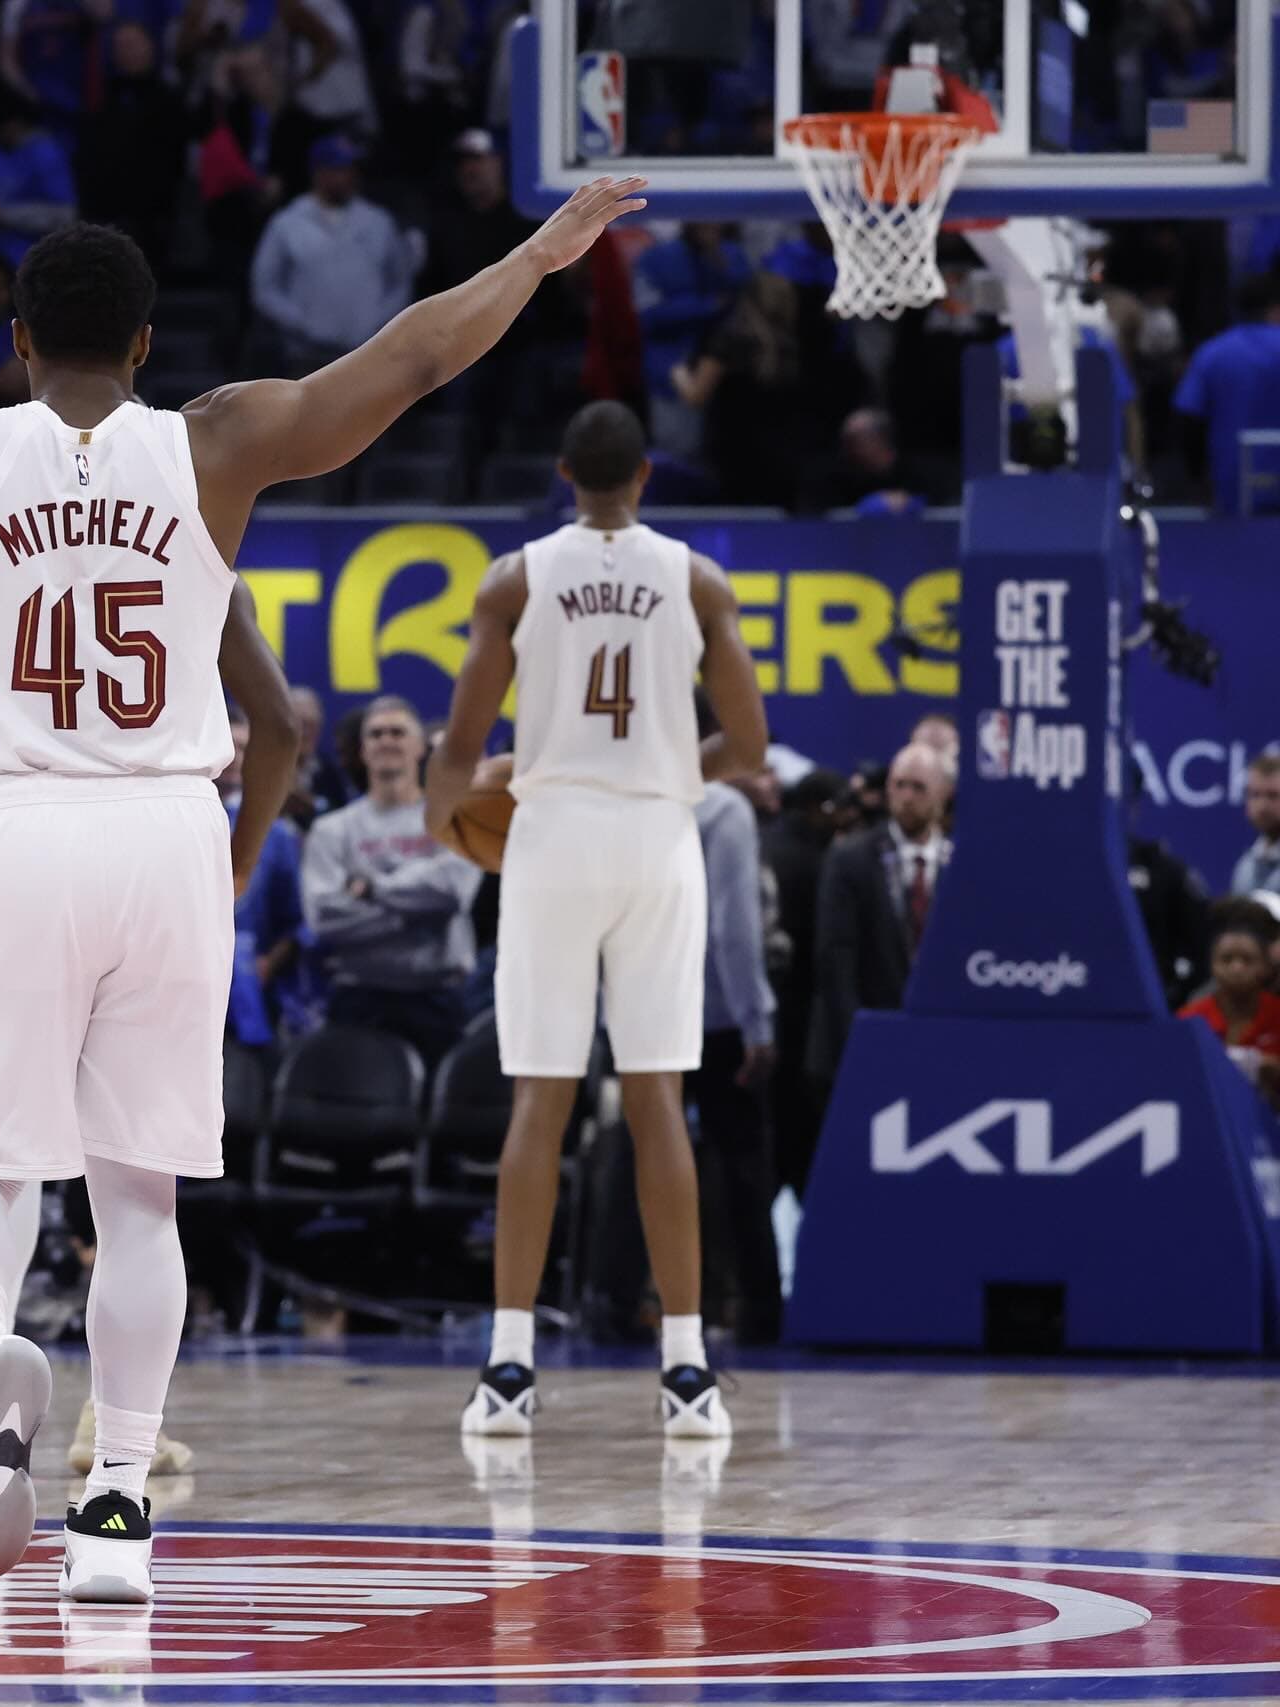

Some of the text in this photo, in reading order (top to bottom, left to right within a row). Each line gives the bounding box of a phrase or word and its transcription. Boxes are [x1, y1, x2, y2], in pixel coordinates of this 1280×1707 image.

[558, 581, 664, 622] MOBLEY
[996, 579, 1070, 642] GET
[11, 580, 167, 730] 45
[995, 646, 1070, 708] THE
[584, 642, 636, 740] 4
[1012, 712, 1086, 790] App
[966, 949, 1088, 996] Google
[871, 1098, 1179, 1177] KIA
